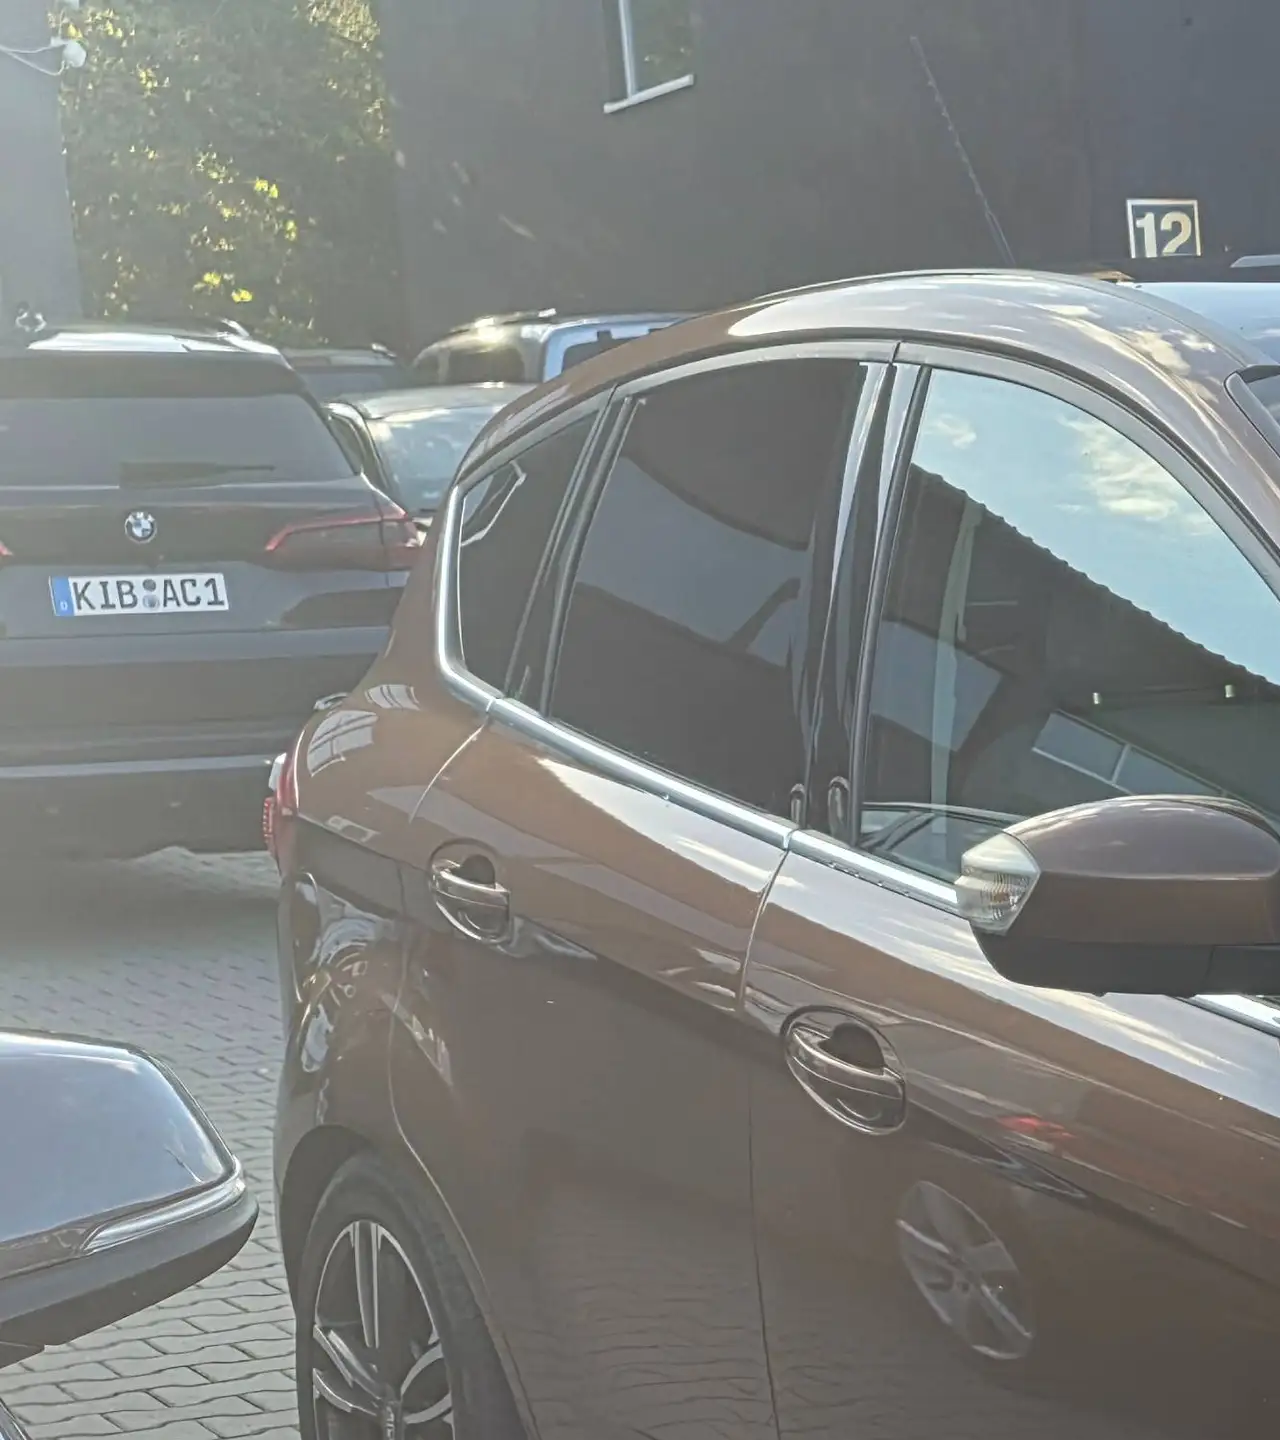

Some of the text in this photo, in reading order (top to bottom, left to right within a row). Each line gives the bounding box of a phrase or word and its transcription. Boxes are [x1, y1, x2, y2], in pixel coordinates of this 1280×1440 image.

[1136, 211, 1192, 258] 12
[72, 580, 139, 611] KIB
[162, 578, 225, 608] AC1
